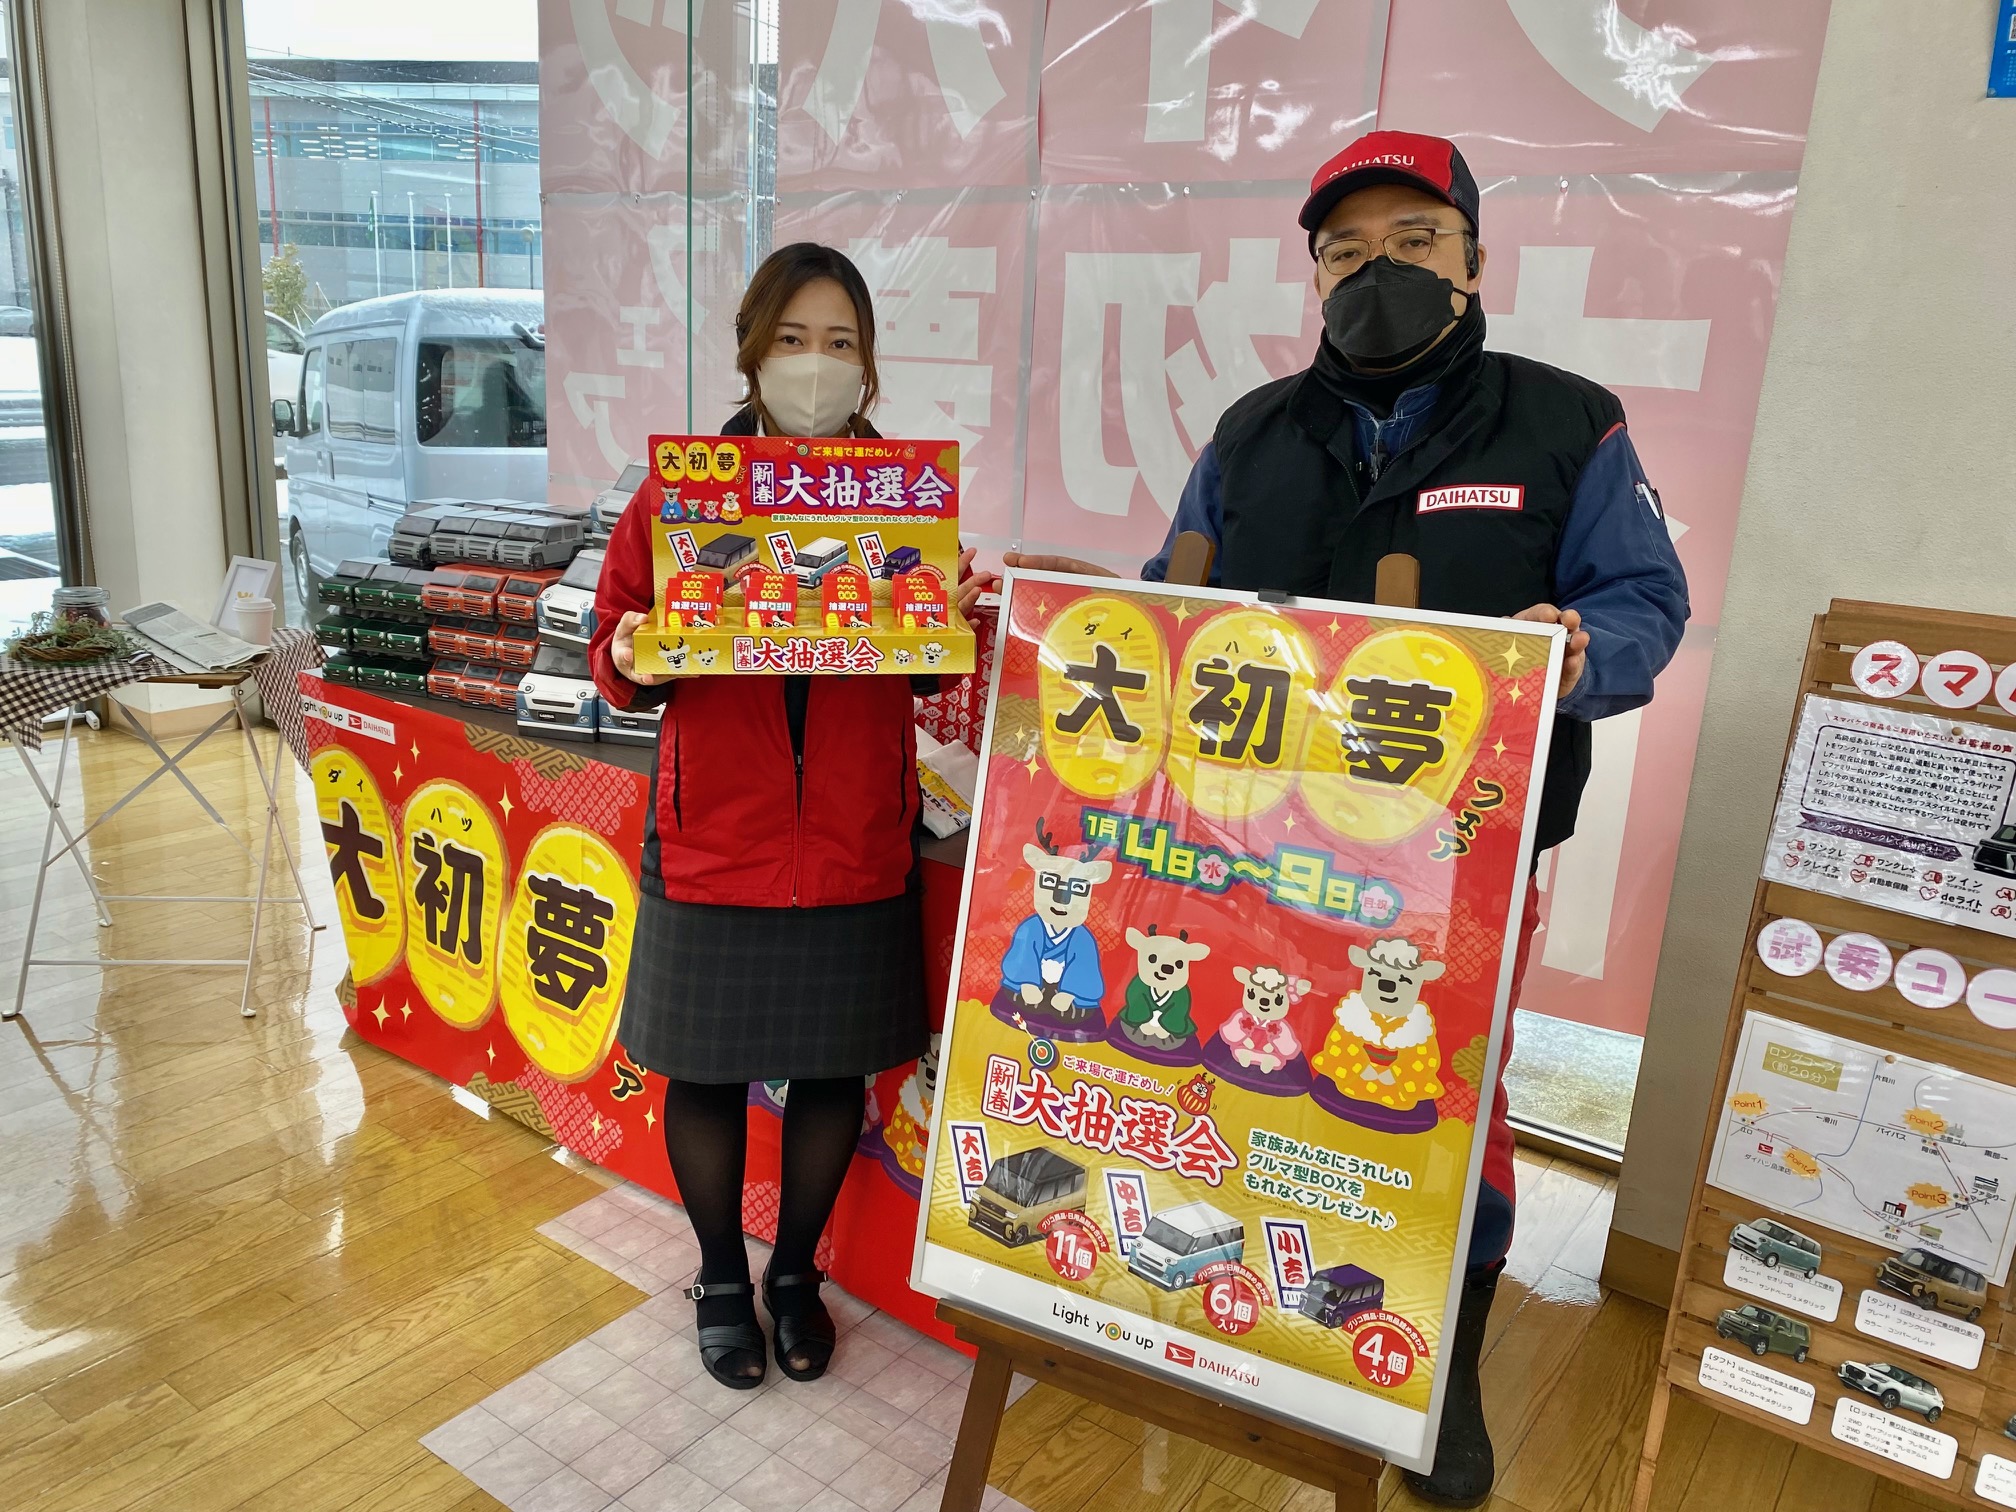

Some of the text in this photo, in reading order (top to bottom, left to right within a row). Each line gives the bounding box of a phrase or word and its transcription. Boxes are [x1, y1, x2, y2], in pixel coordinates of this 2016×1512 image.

[662, 452, 735, 471] 大初夢
[753, 465, 772, 503] 新春
[776, 464, 953, 508] 大抽選会
[1425, 488, 1511, 508] DAIHATSU
[677, 536, 695, 564] 大吉
[775, 538, 794, 565] 中吉
[865, 539, 882, 566] 小吉
[736, 641, 751, 668] 新春
[754, 640, 883, 669] 大抽選会
[334, 712, 344, 723] up
[363, 721, 391, 737] DAIHATSU
[1054, 645, 1457, 787] 大初夢
[1957, 736, 2014, 755] お客様の声
[1426, 777, 1507, 861] フェア
[1809, 843, 1846, 857] ワンクレ
[1803, 860, 1841, 873] クレイチ
[1869, 877, 1909, 892] 自動車保険
[1947, 875, 1983, 888] ツイン
[320, 799, 615, 1012] 大初夢
[1941, 893, 1983, 908] deライト
[1769, 1046, 1836, 1073] ロングコース
[988, 1063, 1014, 1113] 新春
[1013, 1074, 1232, 1181] 大抽選会
[1876, 1127, 1907, 1141] バイパス
[961, 1131, 985, 1182] 大吉
[1250, 1130, 1411, 1187] 家族みんなにうれしい
[1249, 1153, 1364, 1198] クルマ型BOXを
[1115, 1180, 1142, 1233] 中吉
[1053, 1230, 1093, 1271] 11個
[1277, 1230, 1305, 1285] 小吉
[1059, 1265, 1080, 1280] 入り
[1209, 1283, 1253, 1324] 6個
[1052, 1303, 1090, 1329] Light
[1135, 1334, 1155, 1350] up
[1217, 1319, 1239, 1334] 入り
[1358, 1333, 1409, 1376] 4個
[1198, 1357, 1261, 1388] DAIHATSU
[1368, 1369, 1392, 1386] 入り
